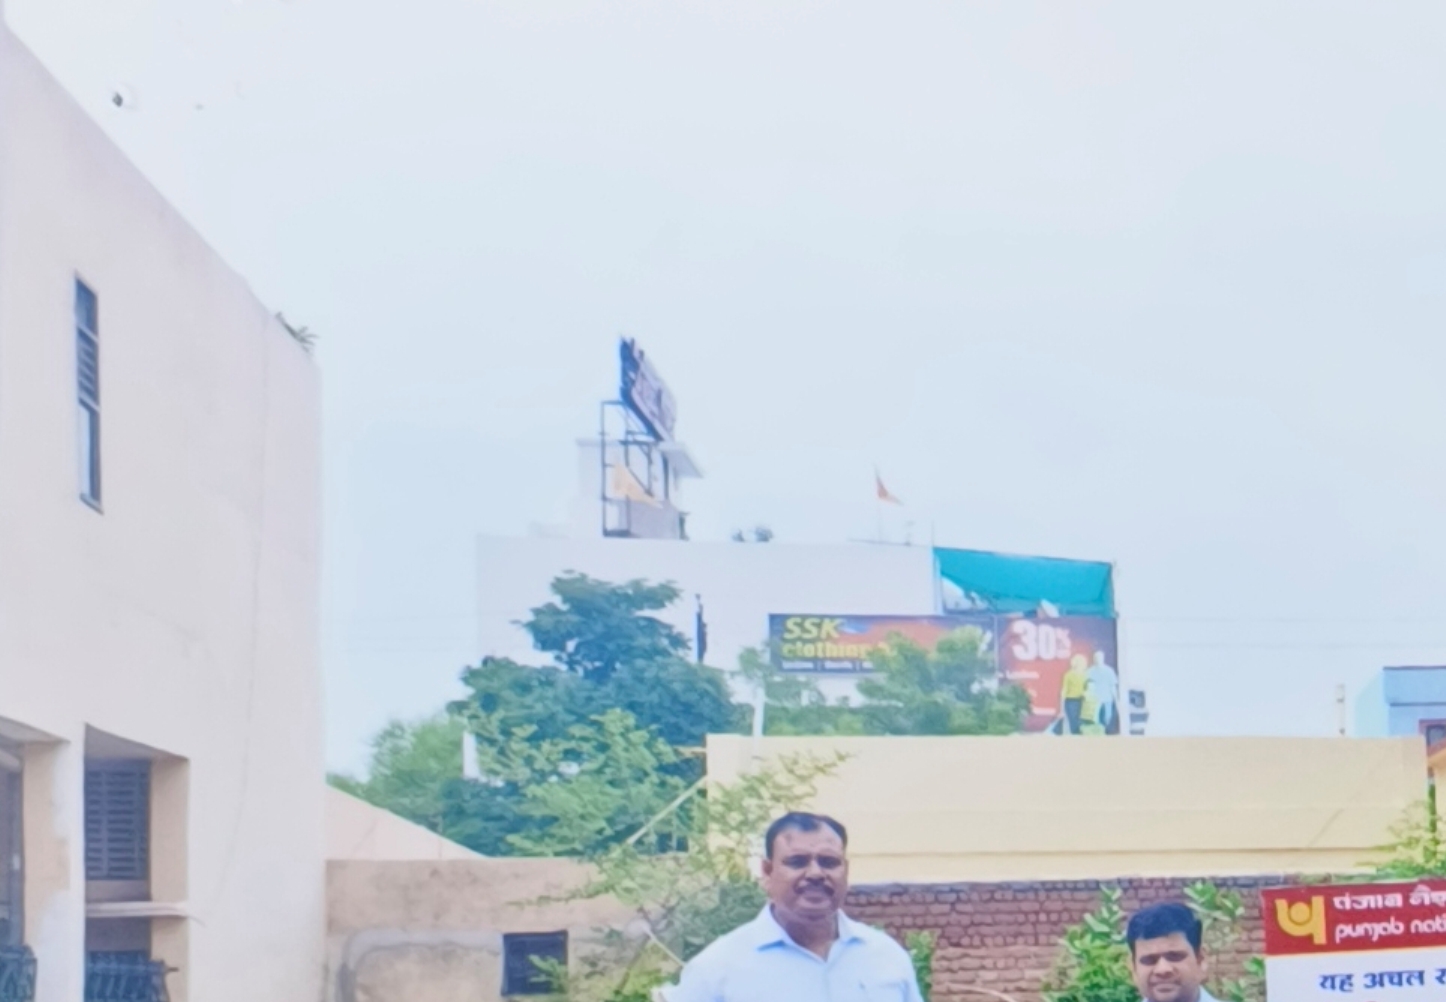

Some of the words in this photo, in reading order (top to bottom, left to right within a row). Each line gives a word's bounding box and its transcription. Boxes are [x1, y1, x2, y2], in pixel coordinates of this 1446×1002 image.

[782, 615, 841, 640] SSK
[1333, 893, 1403, 910] पंजाब
[1335, 917, 1404, 943] punjab
[1320, 974, 1353, 992] यह
[1365, 970, 1424, 988] अचल
